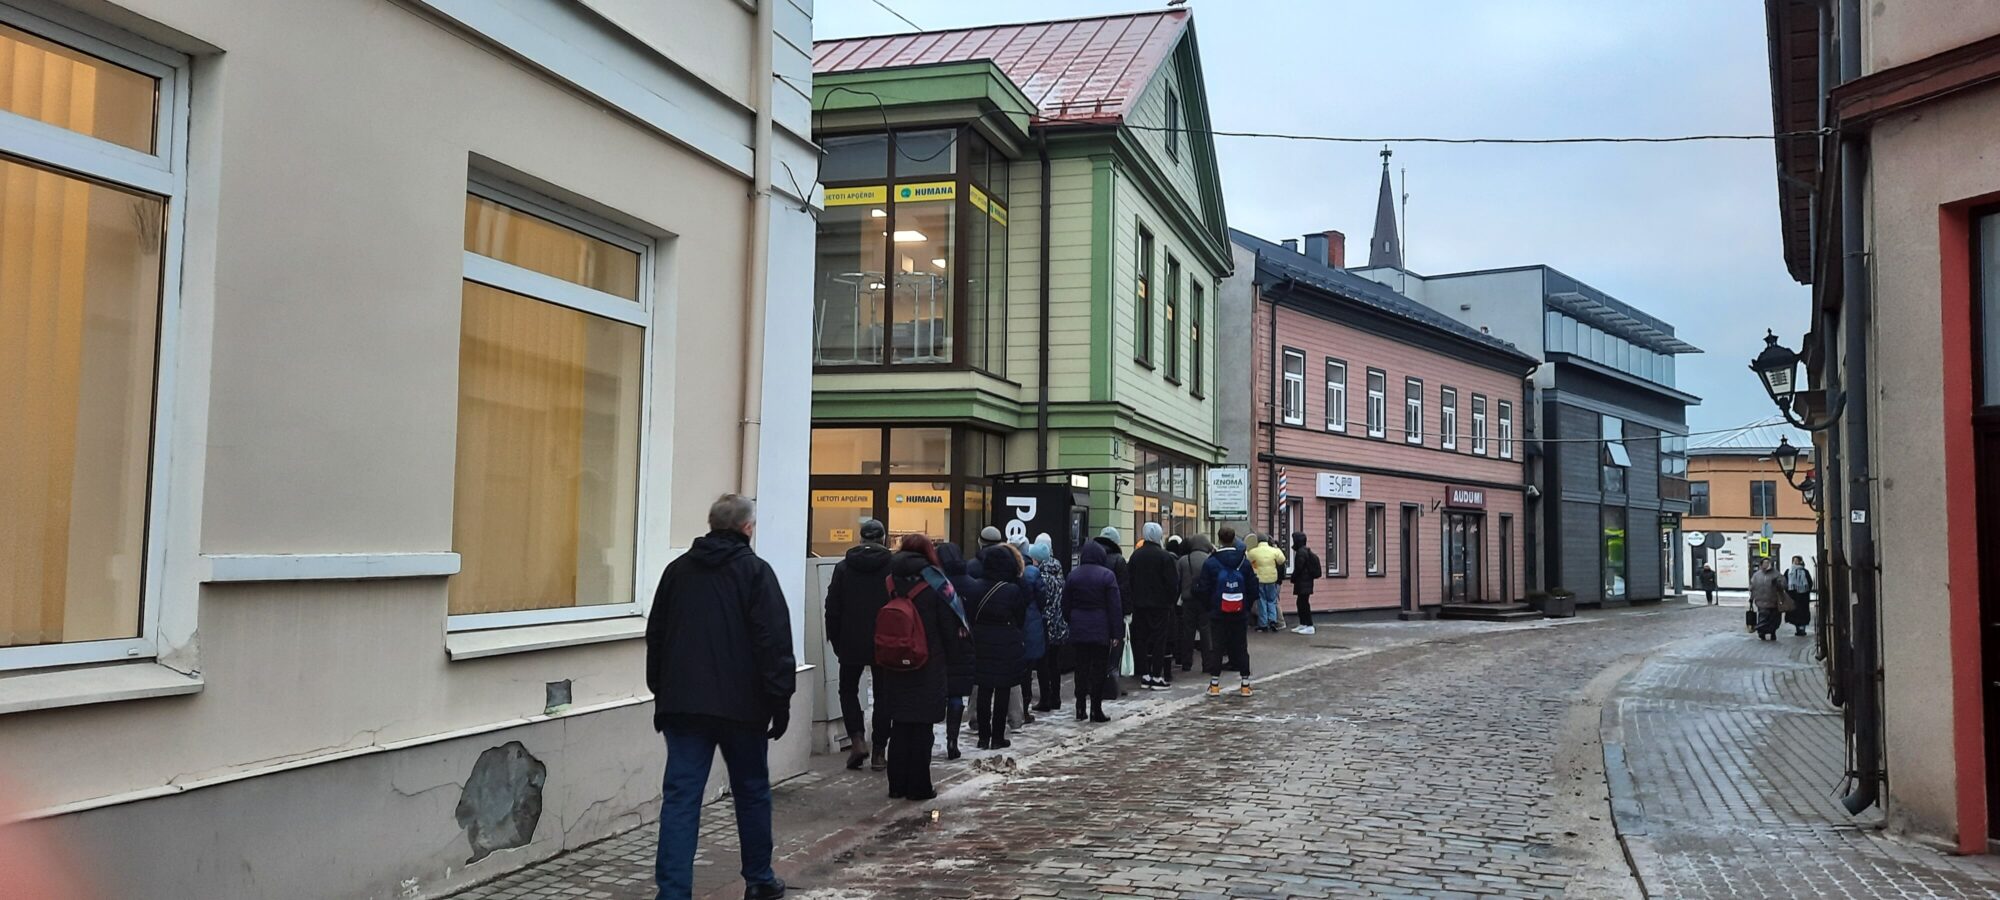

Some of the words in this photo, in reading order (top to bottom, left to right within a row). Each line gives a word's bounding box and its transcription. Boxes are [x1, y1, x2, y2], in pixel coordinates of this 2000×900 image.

[915, 186, 953, 197] HUMANA
[906, 495, 943, 503] HUMANA
[1453, 489, 1483, 504] AUDUMI
